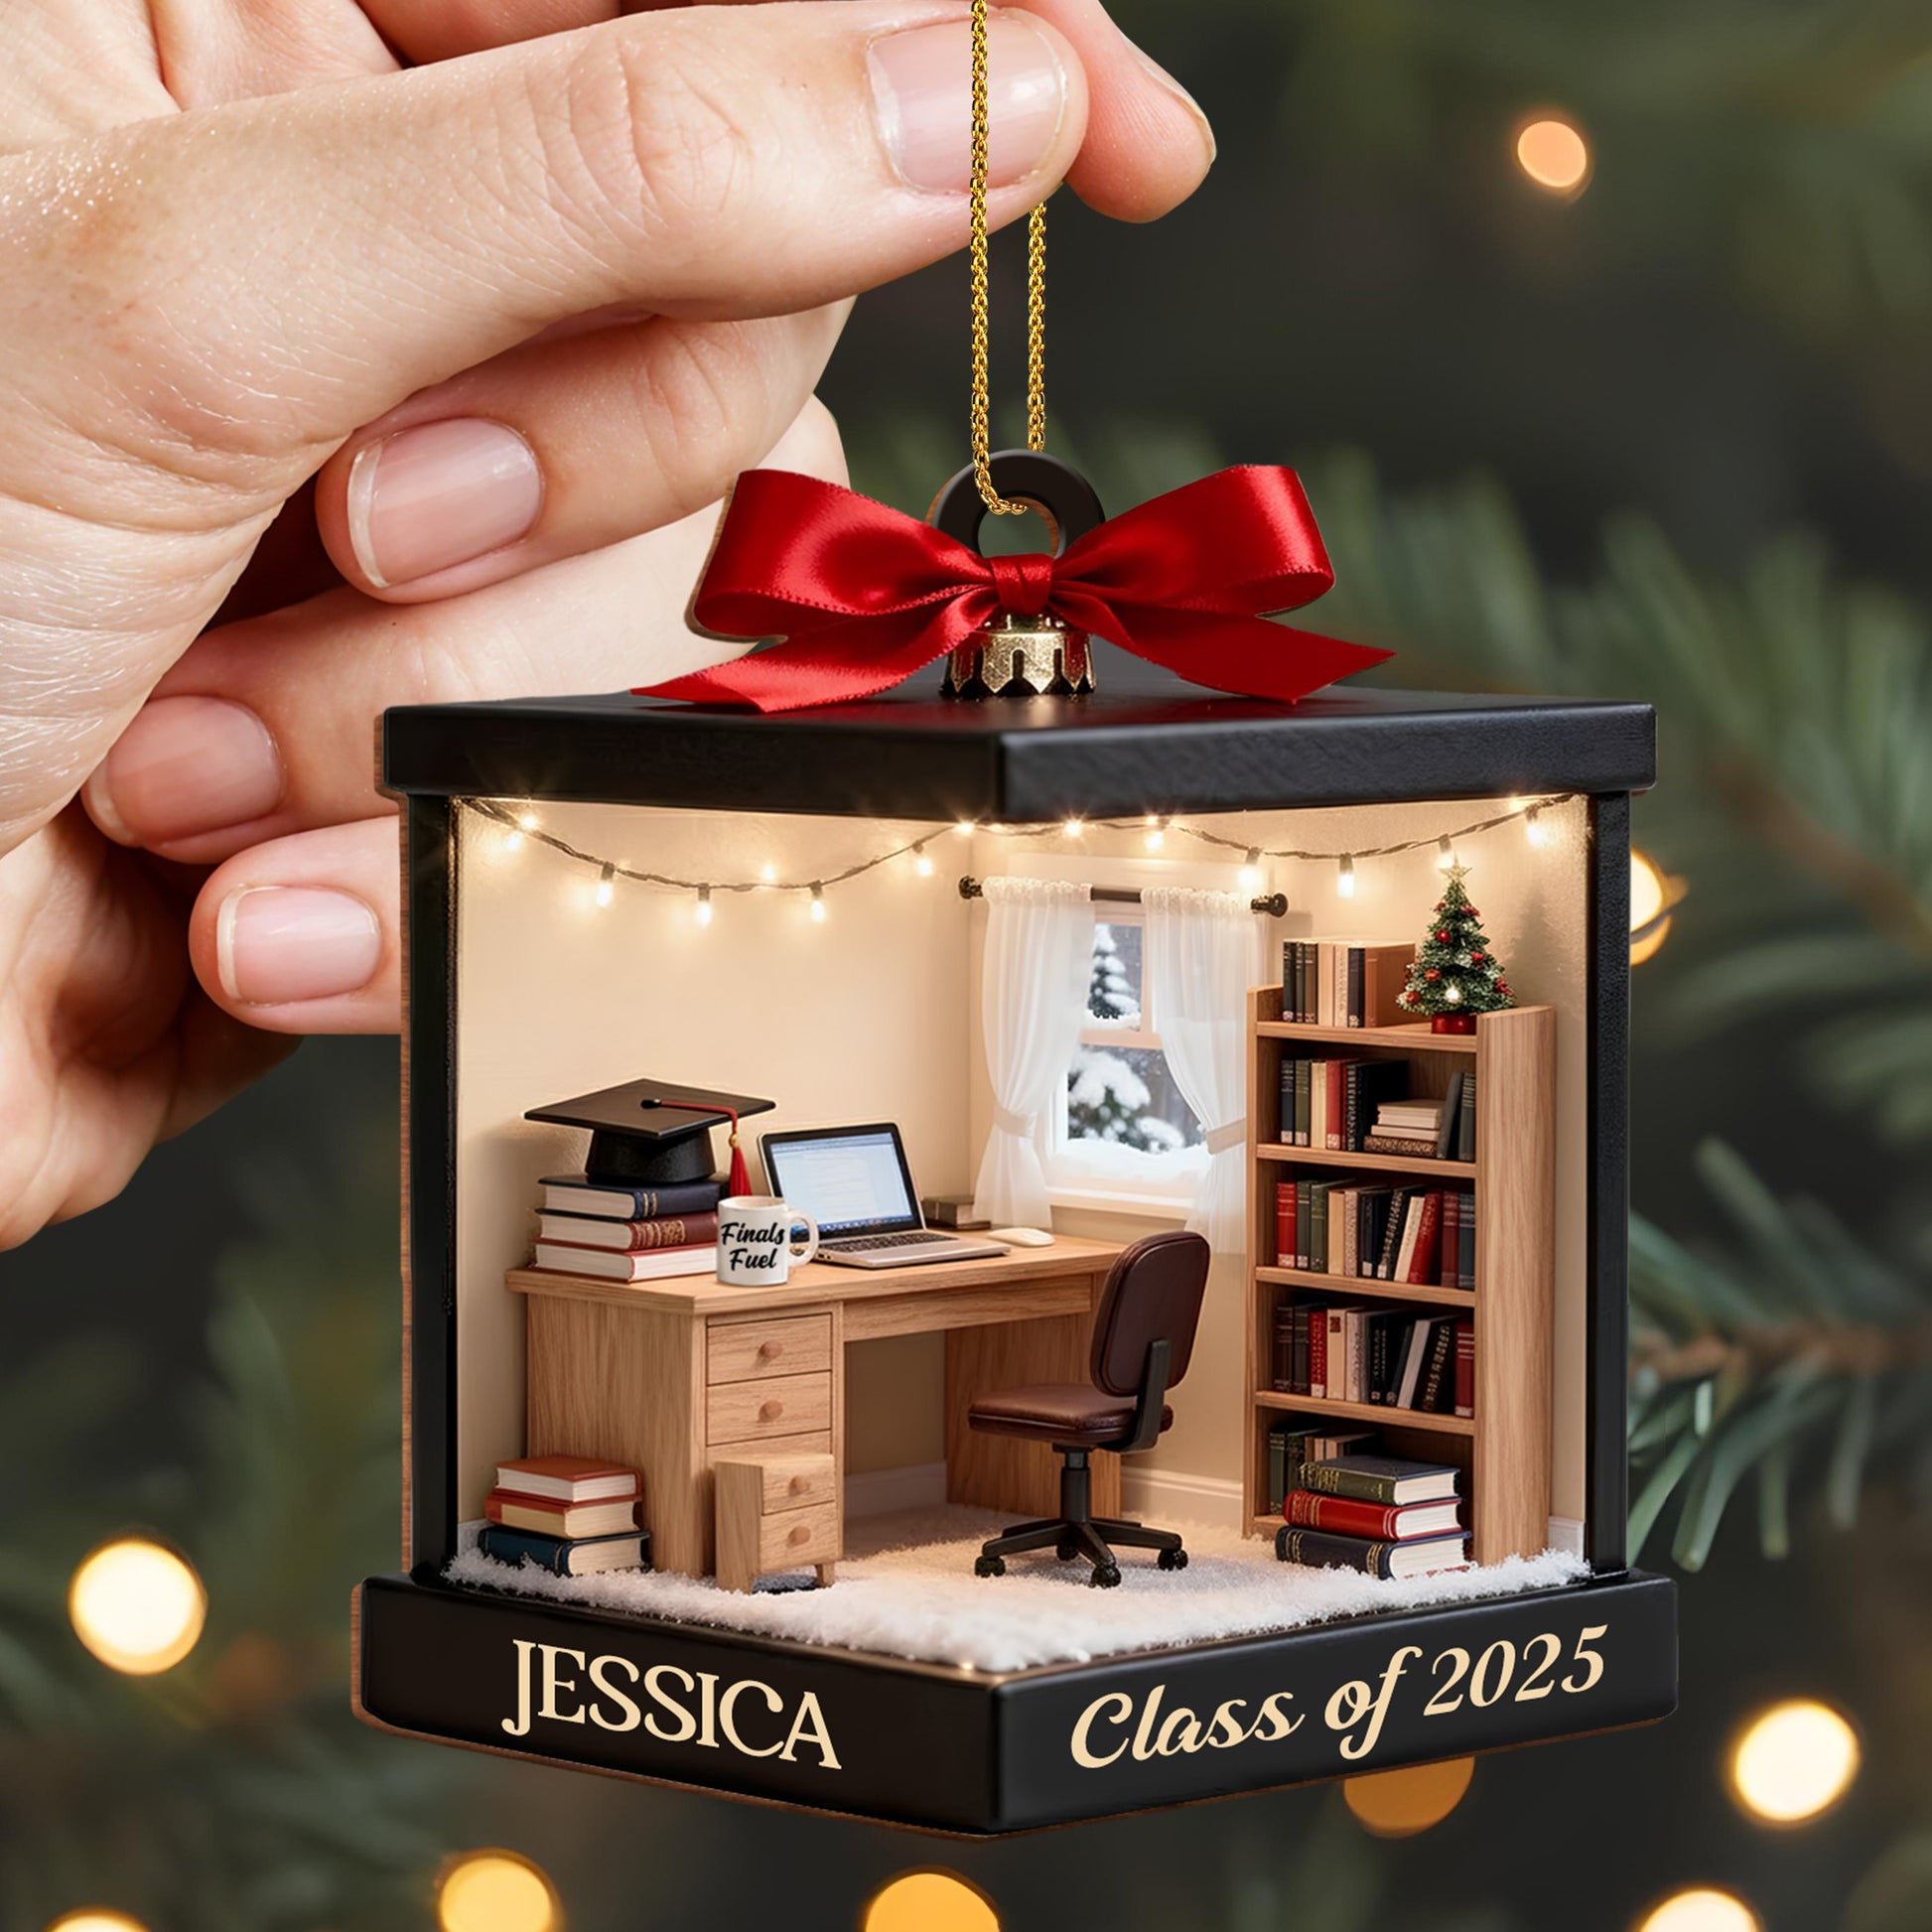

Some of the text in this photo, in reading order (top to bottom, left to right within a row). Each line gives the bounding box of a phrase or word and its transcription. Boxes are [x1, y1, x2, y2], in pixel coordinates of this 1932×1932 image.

[720, 1221, 785, 1246] Finals
[729, 1247, 778, 1272] Fuel
[500, 1639, 842, 1770] JESSICA
[1070, 1624, 1608, 1769] Class of 2025
